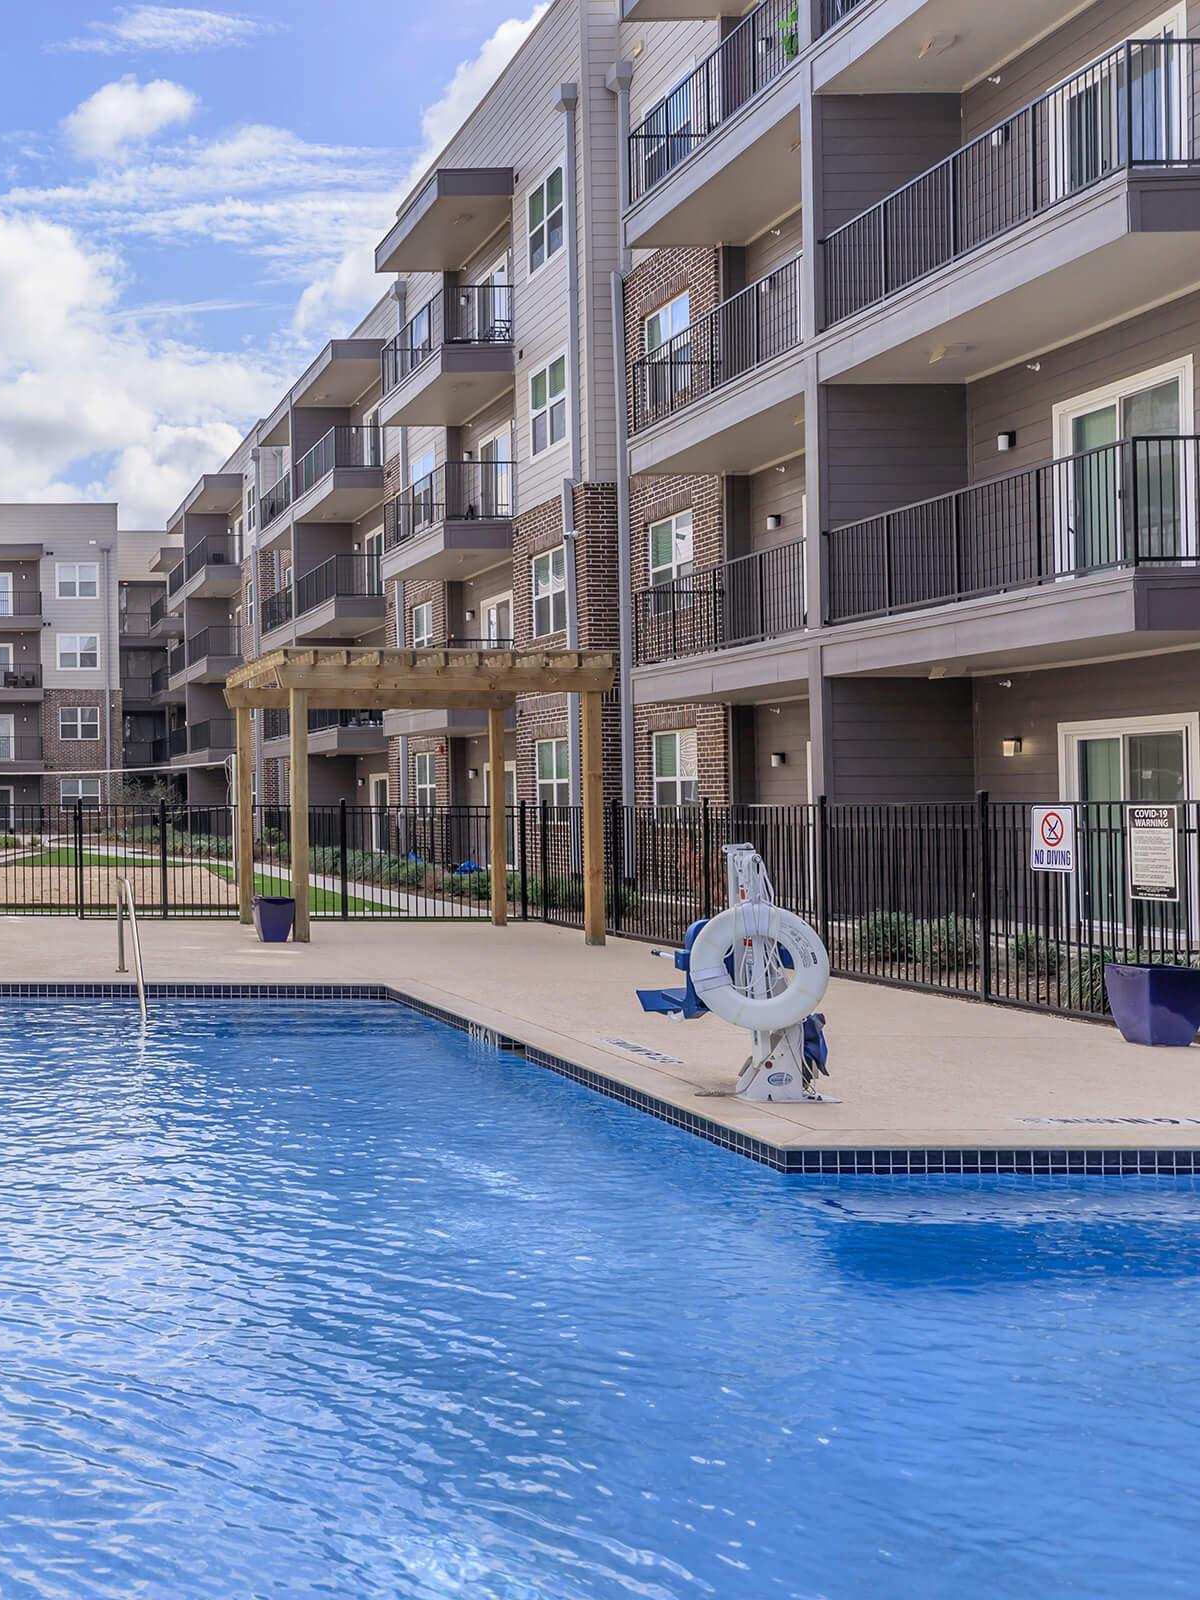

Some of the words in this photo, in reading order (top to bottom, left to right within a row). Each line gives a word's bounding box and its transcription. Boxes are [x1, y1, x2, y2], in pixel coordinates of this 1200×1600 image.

[1135, 809, 1168, 818] COVID-19
[1135, 818, 1169, 827] WARNING
[1034, 849, 1045, 865] NO
[1046, 849, 1071, 866] DIVING
